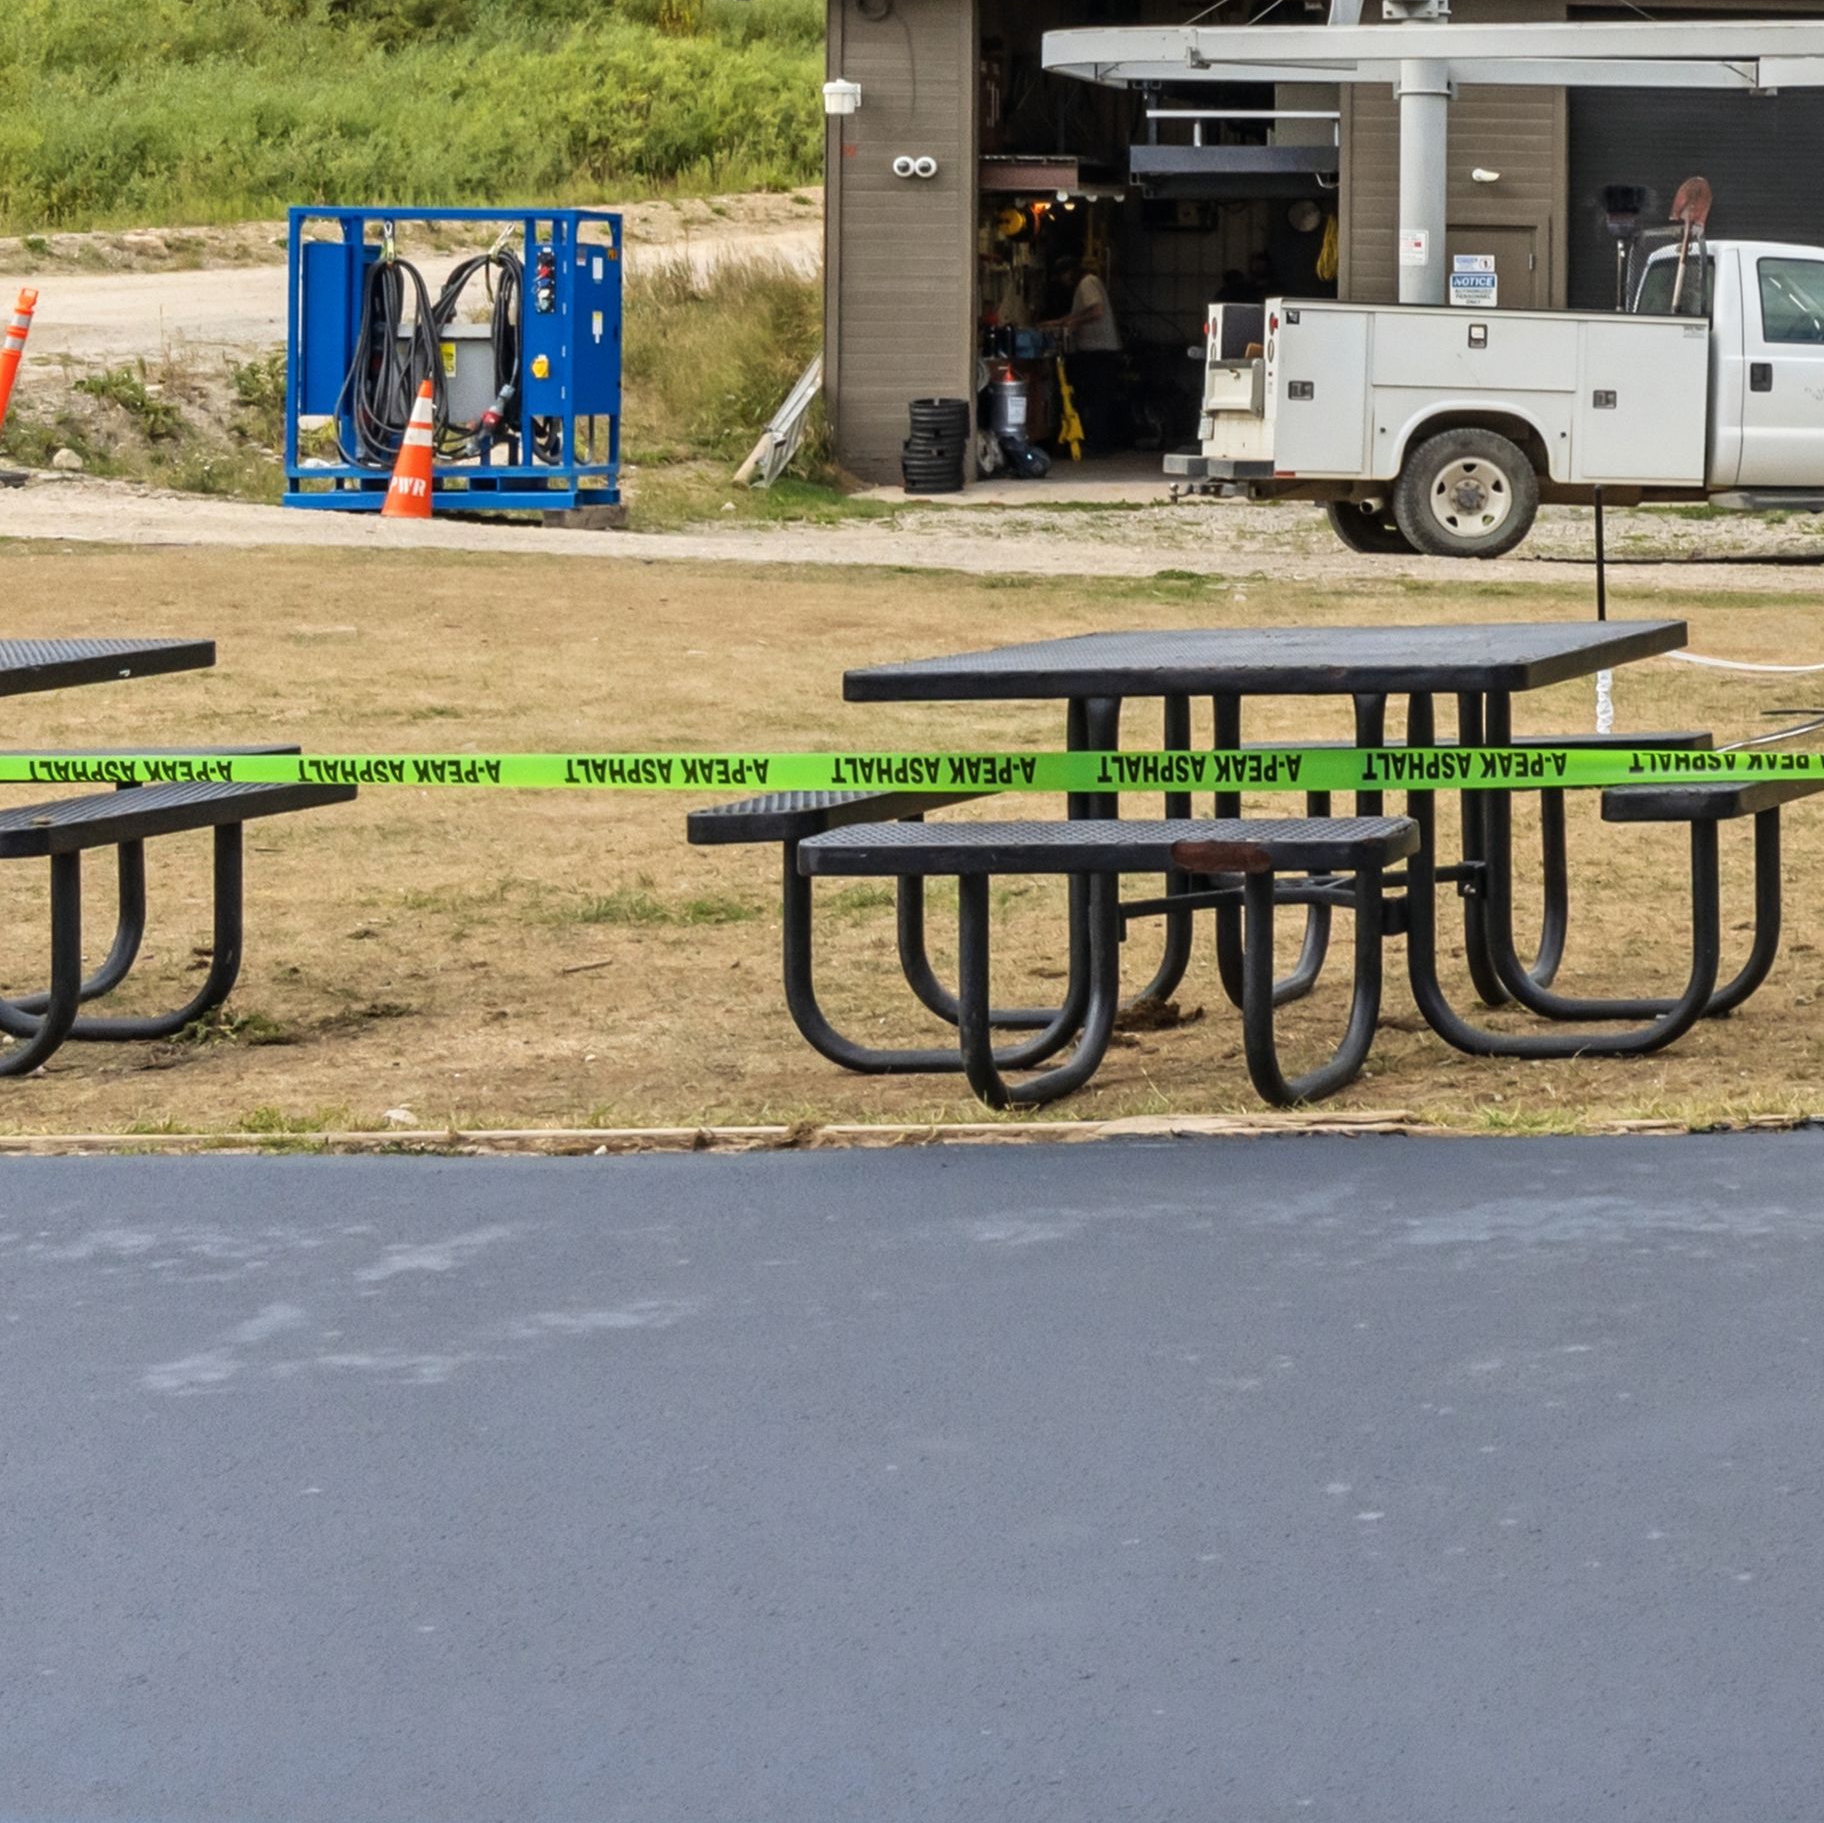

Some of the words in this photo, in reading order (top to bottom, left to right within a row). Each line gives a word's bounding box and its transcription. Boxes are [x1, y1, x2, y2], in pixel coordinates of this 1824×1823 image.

[1453, 277, 1493, 286] NOTICE
[389, 476, 426, 497] PWR
[29, 760, 137, 782] ASPHALT
[143, 760, 233, 783] A-PEAK
[298, 759, 405, 783] ASPHALT
[412, 759, 502, 784] A-PEAK
[565, 759, 673, 784] ASPHALT
[680, 758, 770, 784] A-PEAK
[831, 757, 940, 784] ASPHALT
[948, 757, 1037, 784] A-PEAK
[1097, 755, 1207, 783] ASPHALT
[1213, 754, 1303, 783] A-PEAK
[1361, 753, 1472, 781] ASPHALT
[1480, 752, 1567, 777] A-PEAK
